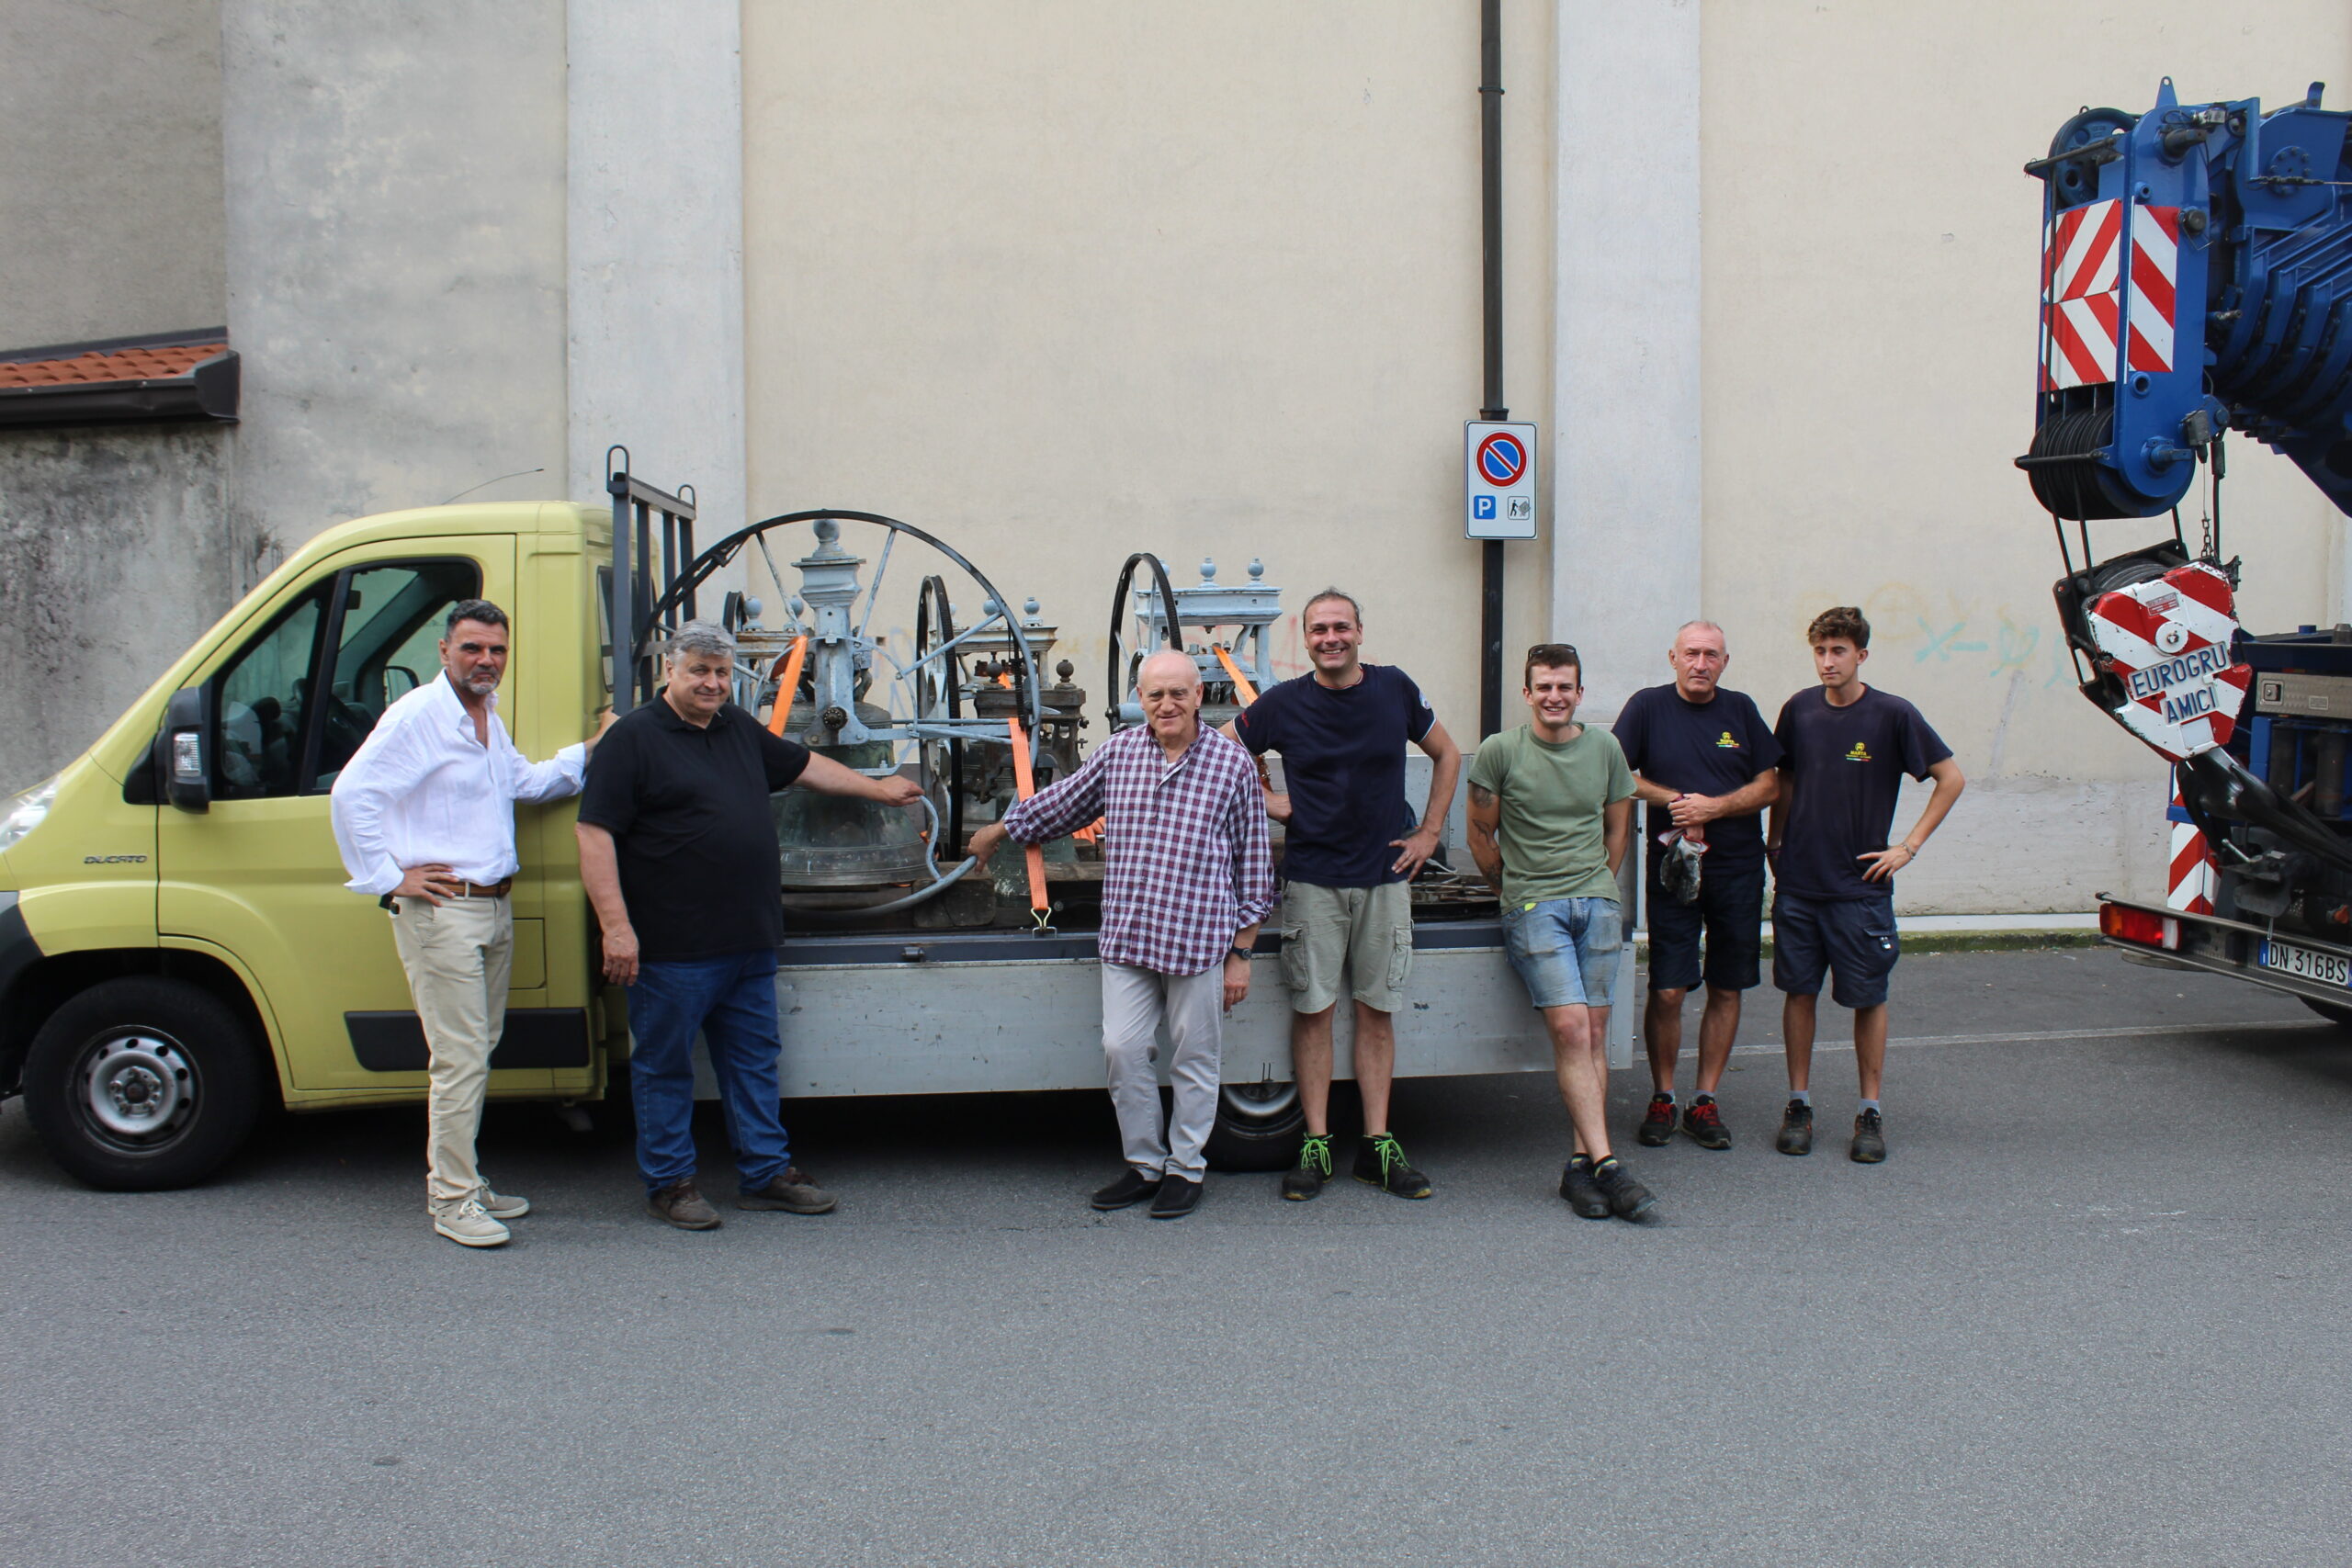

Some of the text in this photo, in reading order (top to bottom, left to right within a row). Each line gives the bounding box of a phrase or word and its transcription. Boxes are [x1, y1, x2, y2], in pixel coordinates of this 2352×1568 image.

[1478, 498, 1492, 516] P
[2132, 644, 2227, 697] EUROGRU
[2166, 686, 2216, 724] AMICI
[84, 855, 148, 864] DUCATO
[2269, 943, 2289, 970] DN
[2295, 949, 2346, 983] 316BS
